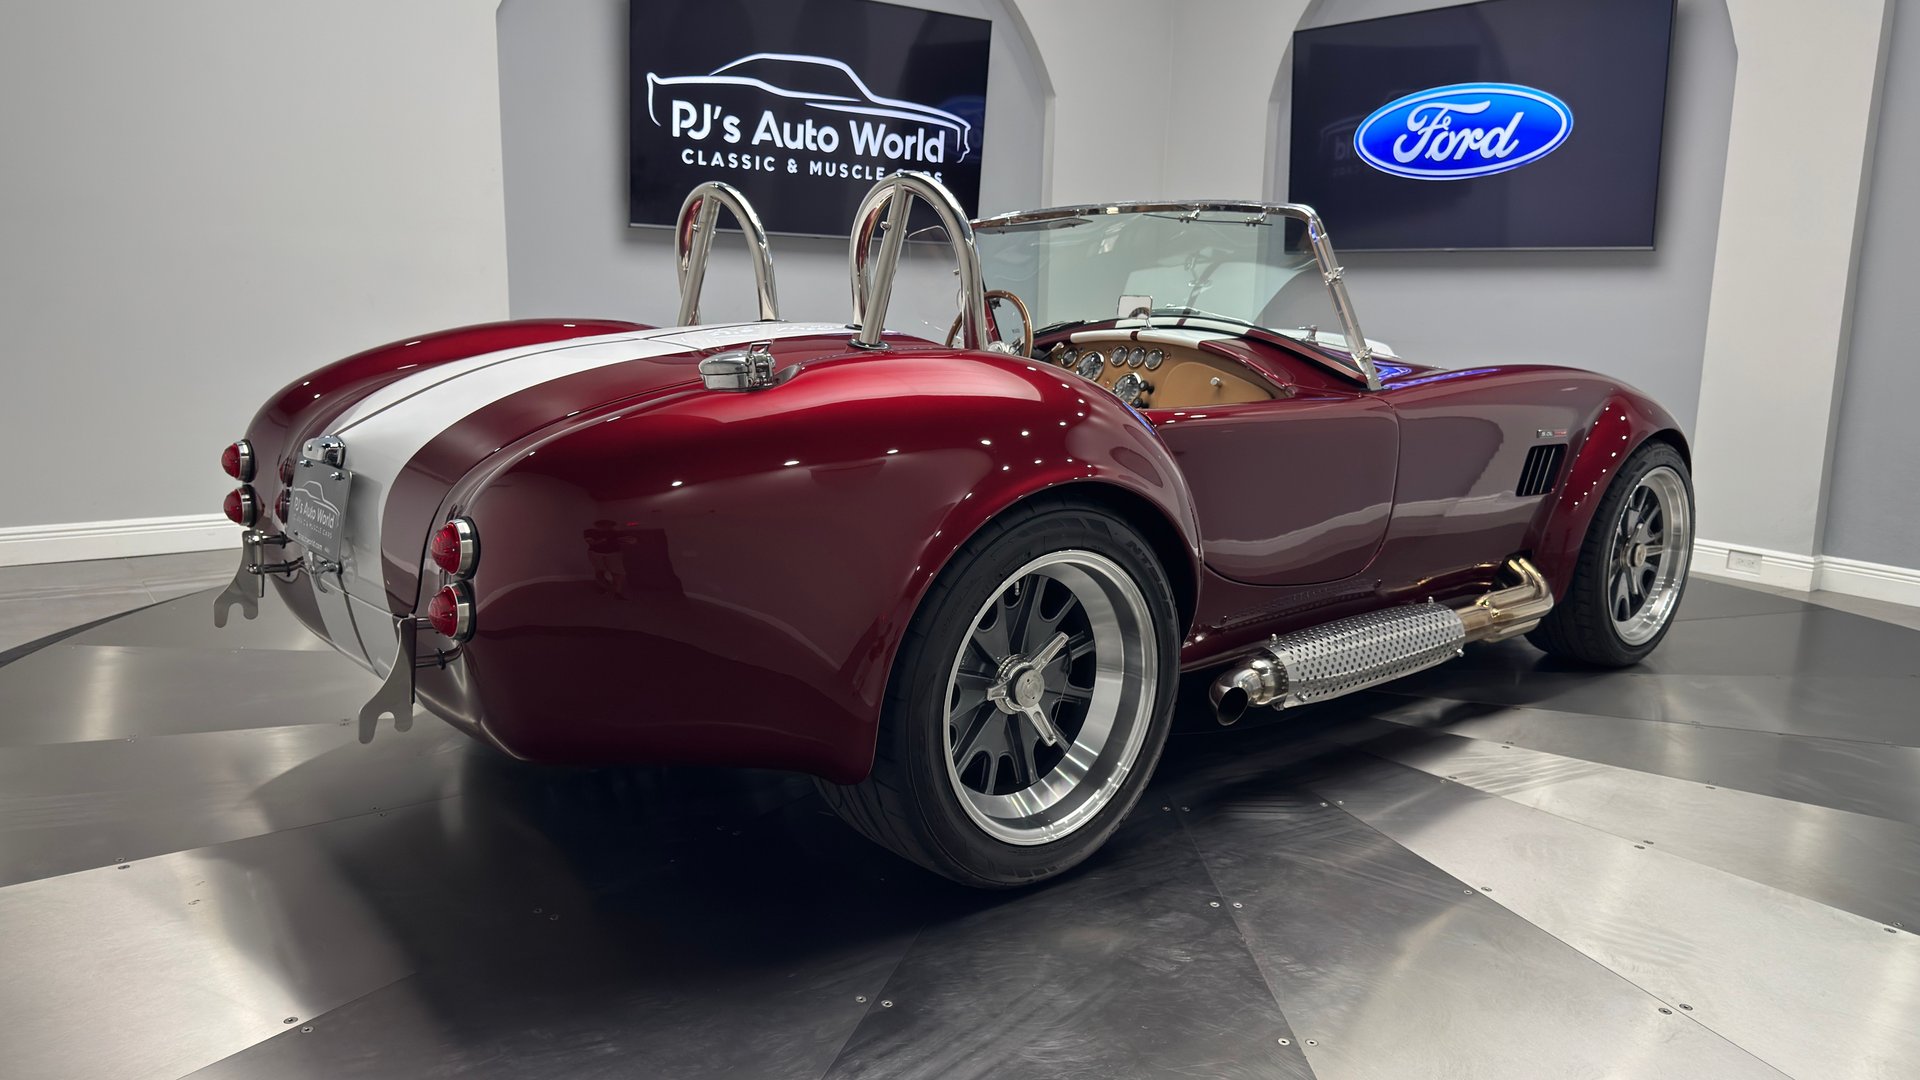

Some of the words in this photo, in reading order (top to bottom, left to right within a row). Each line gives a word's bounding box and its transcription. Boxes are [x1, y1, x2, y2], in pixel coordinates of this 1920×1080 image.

[672, 99, 741, 144] PJ's
[751, 110, 840, 153] Auto
[849, 119, 947, 164] World
[1392, 99, 1525, 165] Ford
[681, 148, 776, 173] CLASSIC
[786, 158, 799, 175] &
[809, 160, 885, 182] MUSCLE
